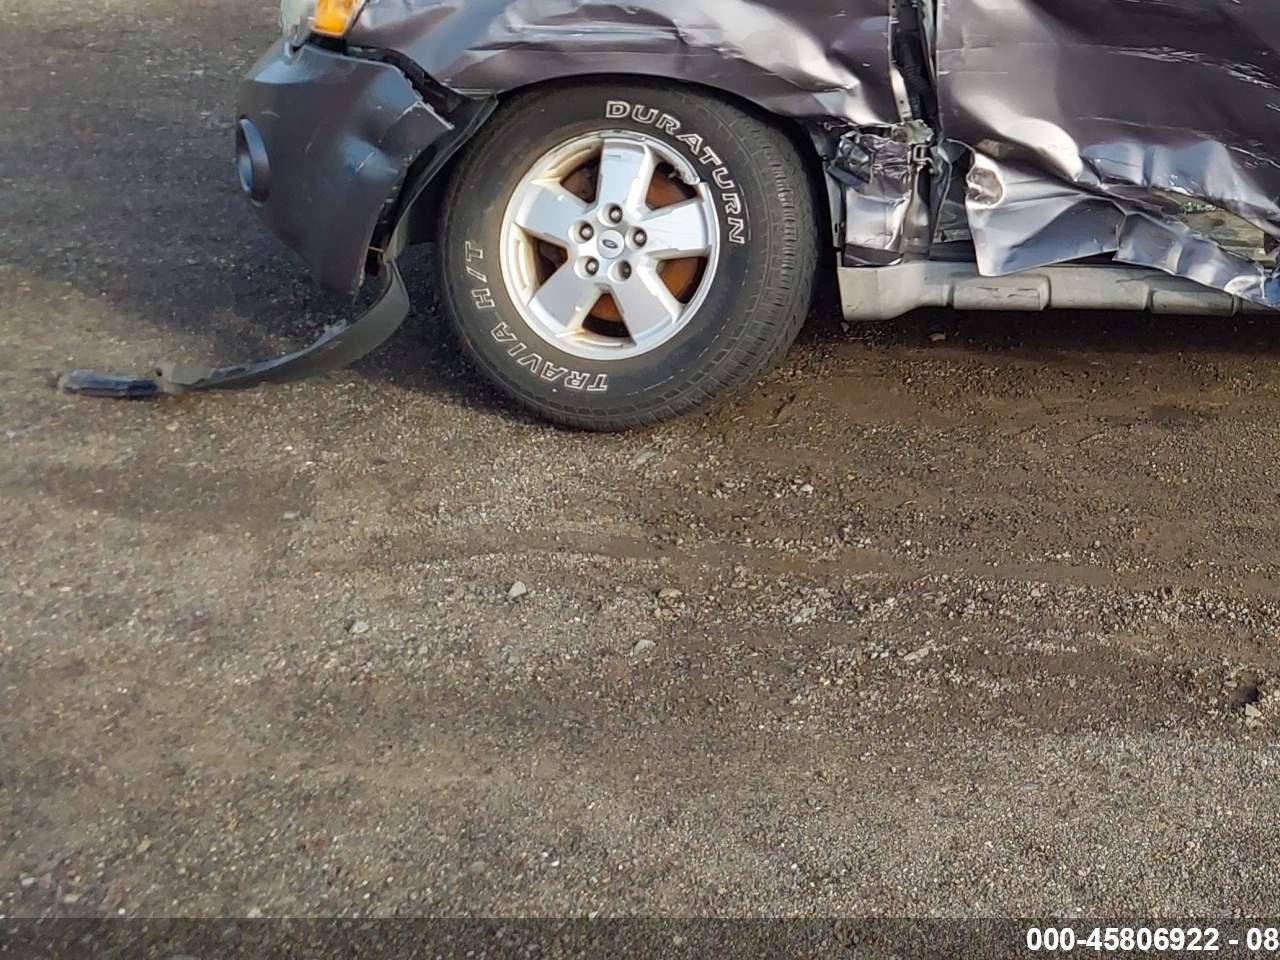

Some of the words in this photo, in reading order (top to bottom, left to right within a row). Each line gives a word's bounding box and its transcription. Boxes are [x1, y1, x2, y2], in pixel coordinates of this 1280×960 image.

[605, 100, 746, 245] DURATURN
[465, 240, 496, 310] H/T
[491, 321, 609, 392] TRAVIA
